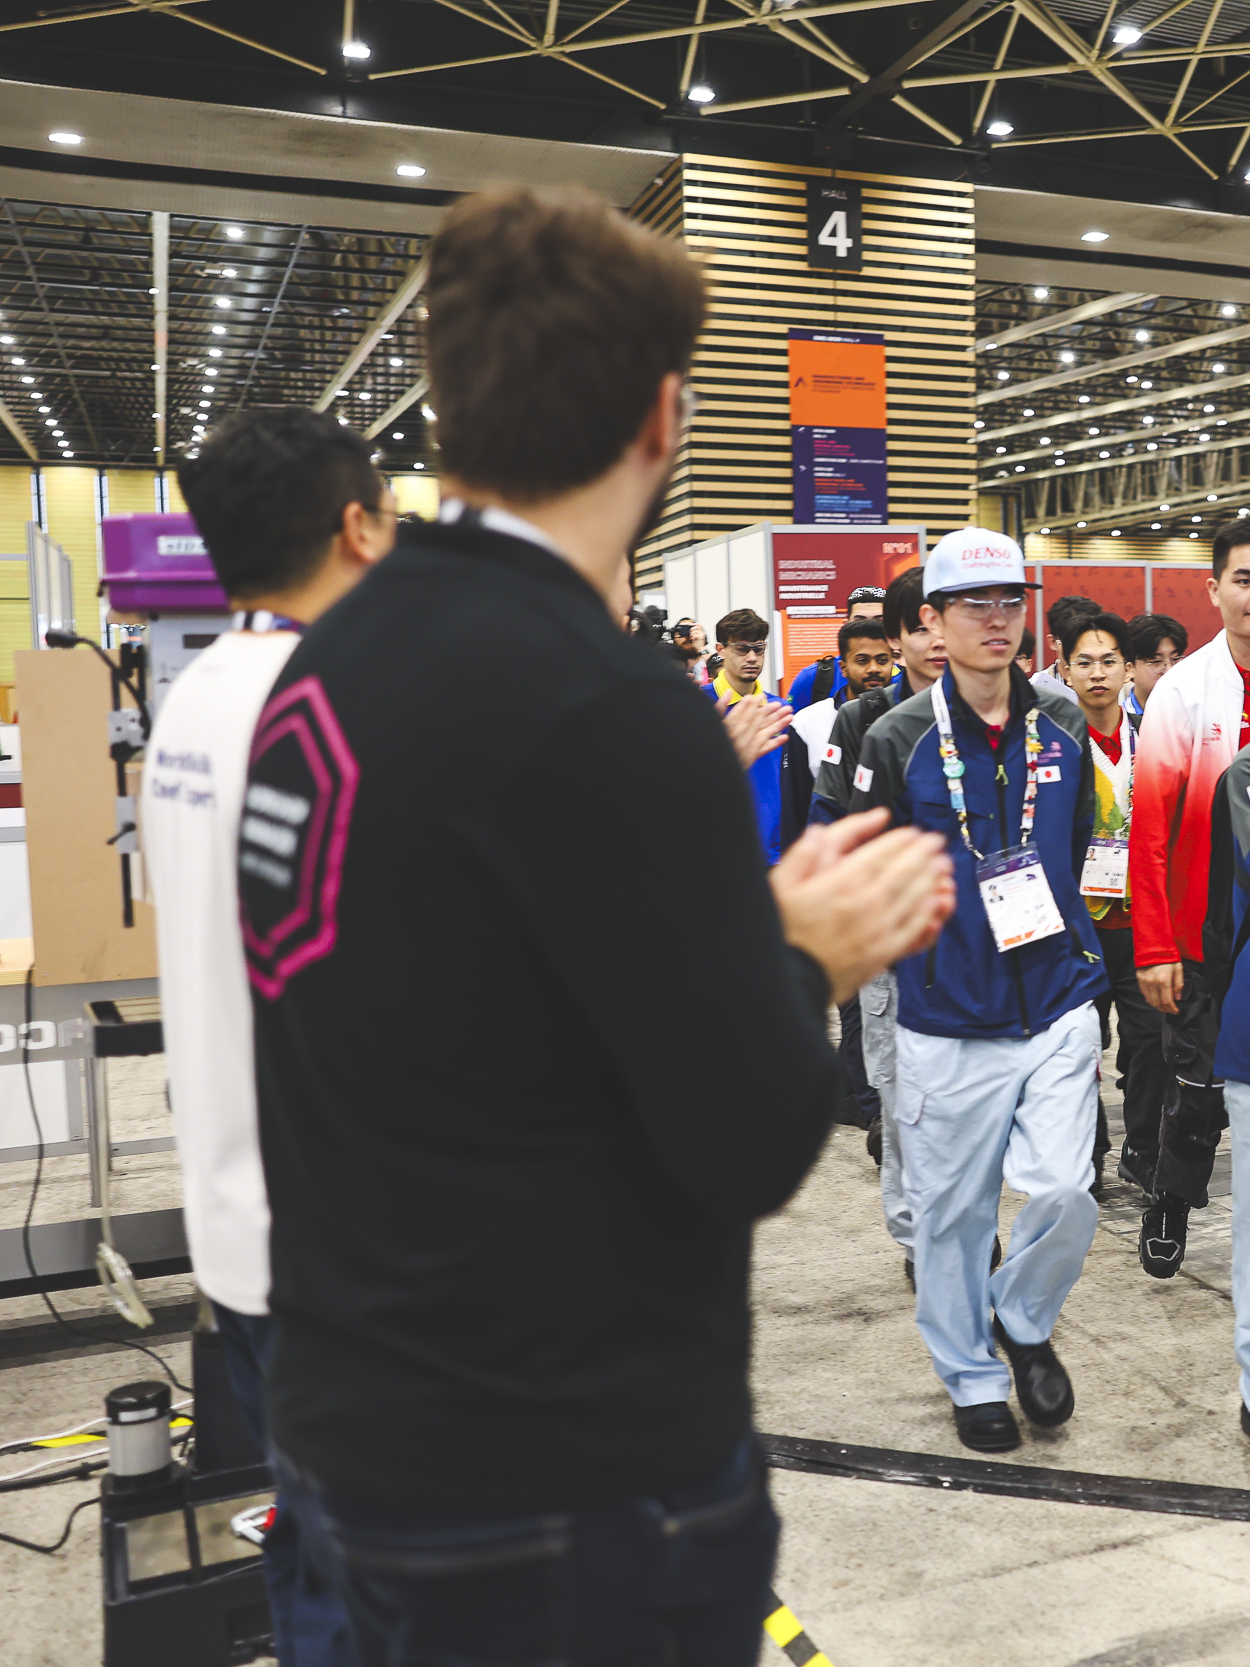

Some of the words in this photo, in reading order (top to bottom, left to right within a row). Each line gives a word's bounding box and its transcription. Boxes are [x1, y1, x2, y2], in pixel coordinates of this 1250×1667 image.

[821, 189, 848, 200] HALL
[818, 211, 853, 258] 4
[962, 547, 1011, 561] DENSO
